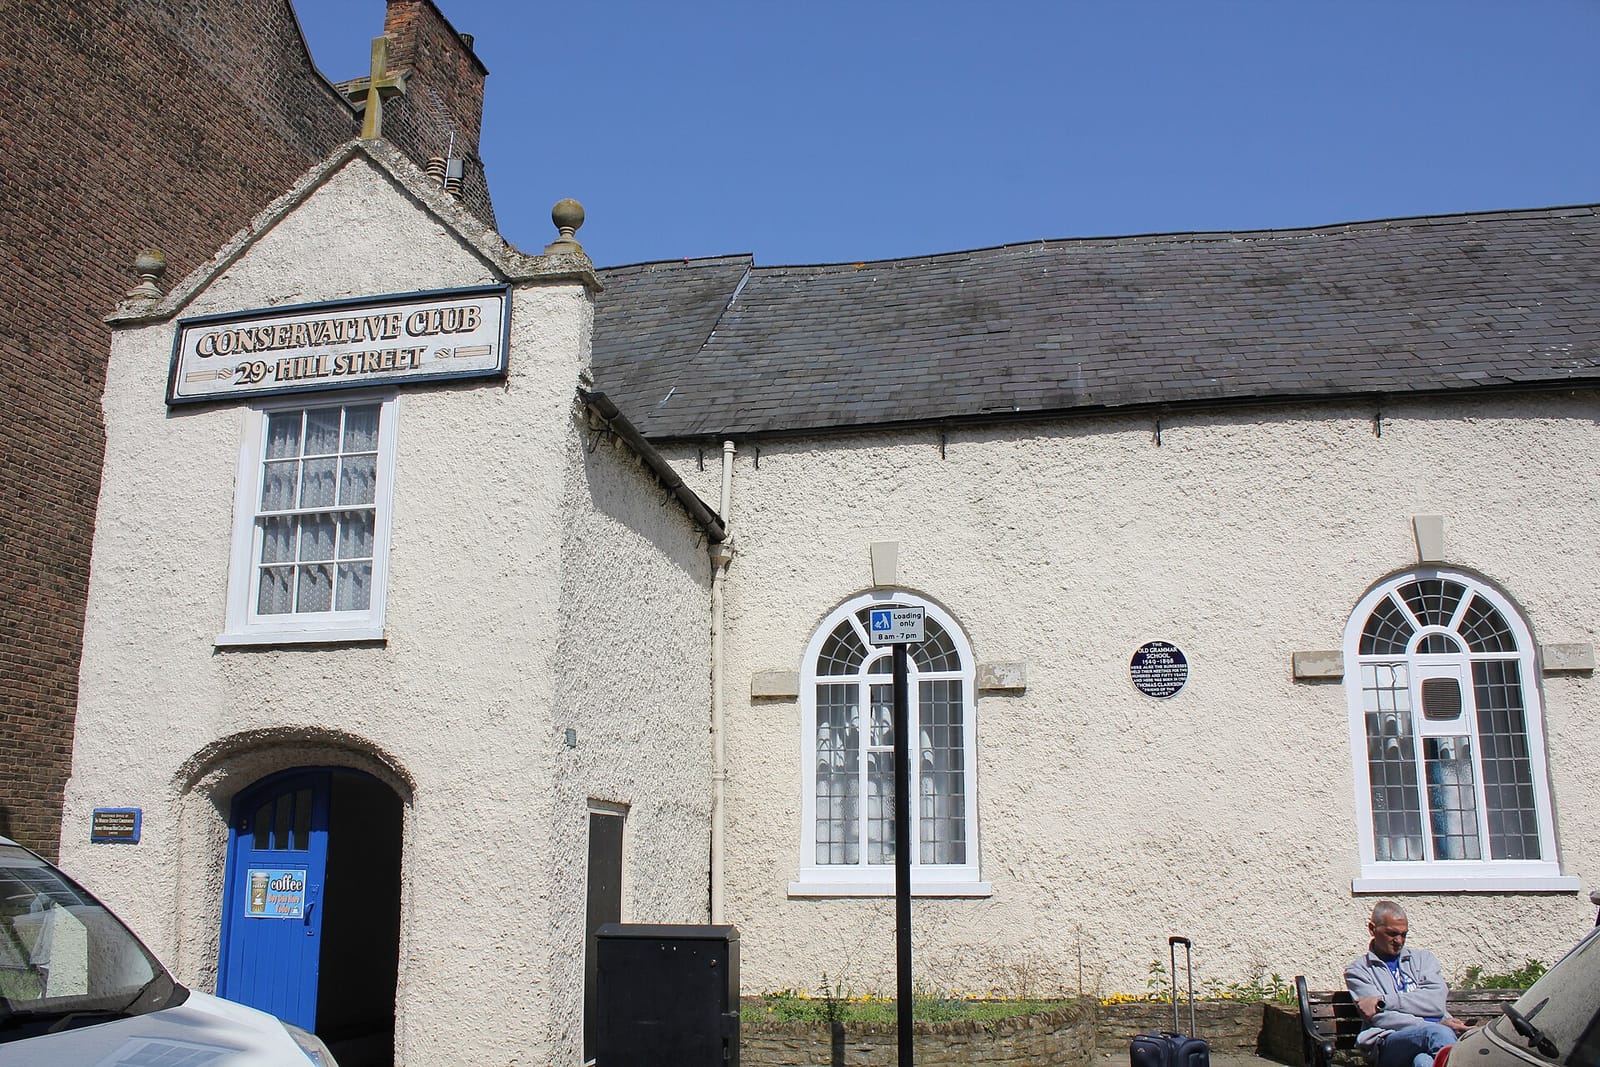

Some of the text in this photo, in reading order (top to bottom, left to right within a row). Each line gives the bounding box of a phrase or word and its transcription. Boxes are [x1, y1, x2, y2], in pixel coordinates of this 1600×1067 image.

[195, 305, 481, 358] CONSERVATIVE CLUB
[275, 357, 332, 382] HILL
[333, 345, 428, 377] STREET
[271, 873, 303, 892] coffee
